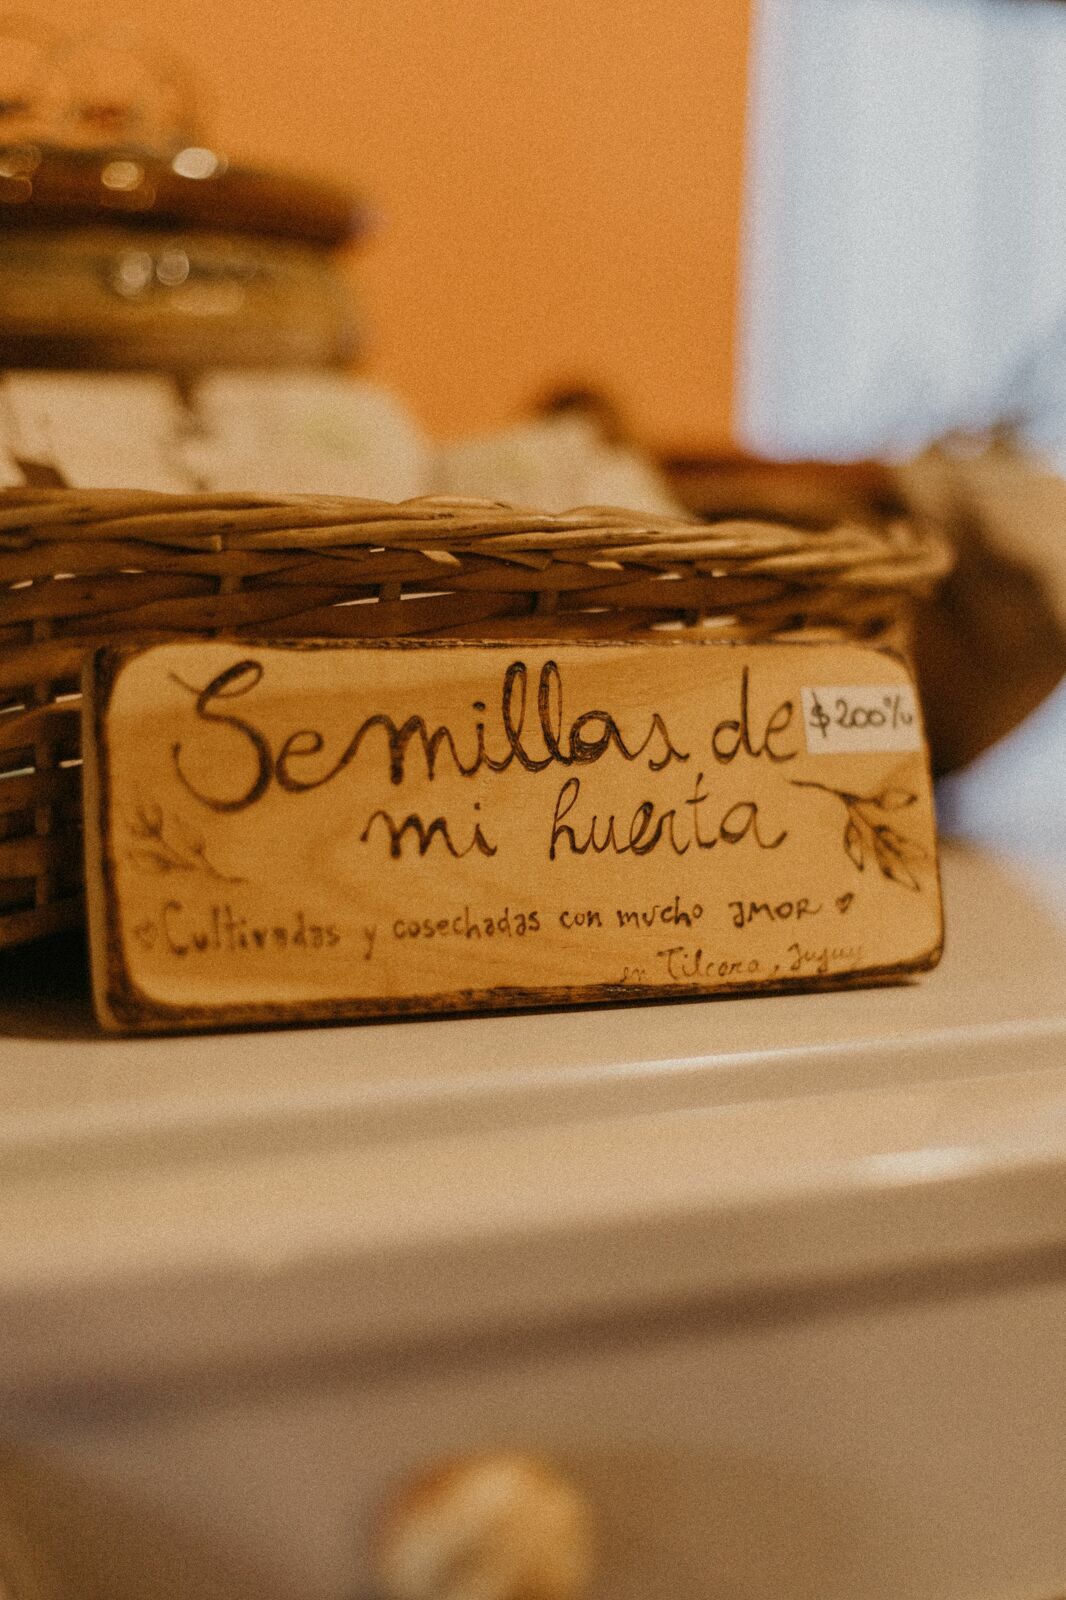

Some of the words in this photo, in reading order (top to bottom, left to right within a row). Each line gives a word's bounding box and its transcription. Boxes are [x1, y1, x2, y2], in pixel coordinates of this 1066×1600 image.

[168, 659, 691, 814] Semillas
[711, 664, 799, 764] de
[360, 800, 498, 859] mi
[549, 771, 789, 861] huerta
[163, 899, 342, 956] Cultivadas
[363, 925, 379, 961] y
[393, 906, 542, 940] cosechadas
[560, 909, 602, 929] con
[617, 895, 704, 928] mucho
